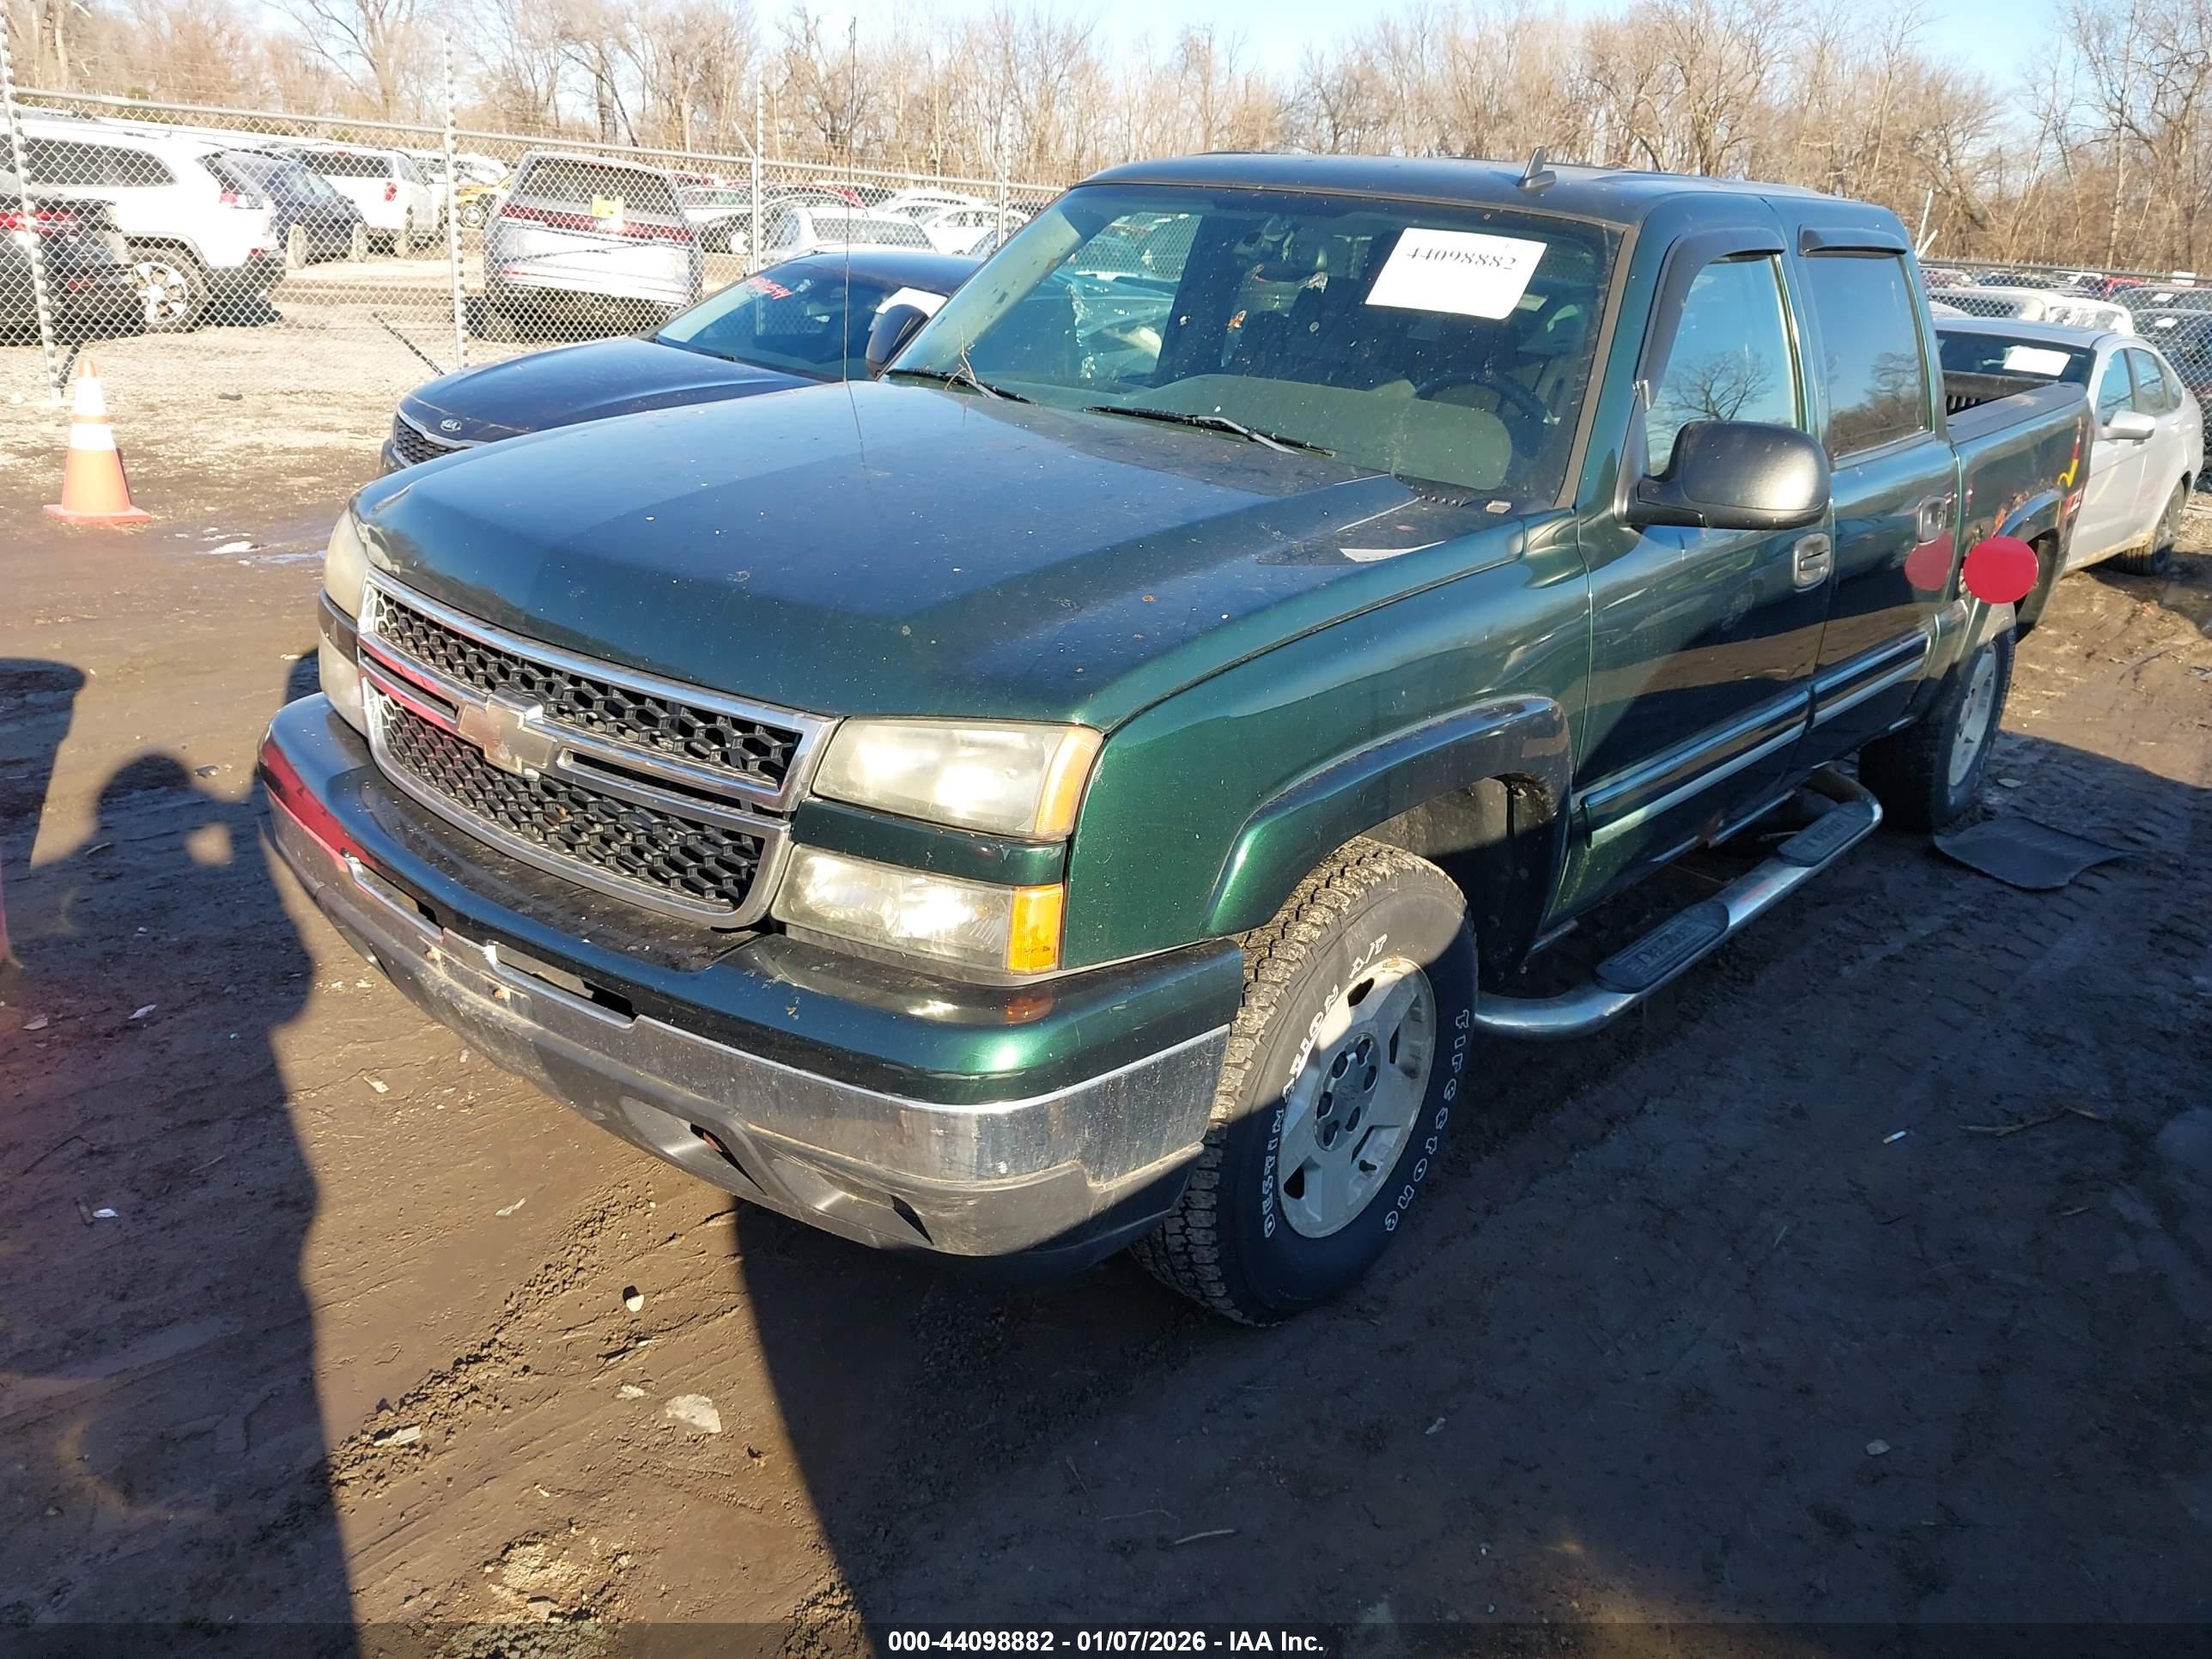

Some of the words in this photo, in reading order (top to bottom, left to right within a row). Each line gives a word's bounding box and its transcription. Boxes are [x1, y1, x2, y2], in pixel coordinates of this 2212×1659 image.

[1406, 246, 1516, 270] 44098882
[1262, 983, 1340, 1238] DESTINATION
[1348, 933, 1389, 980] A/T
